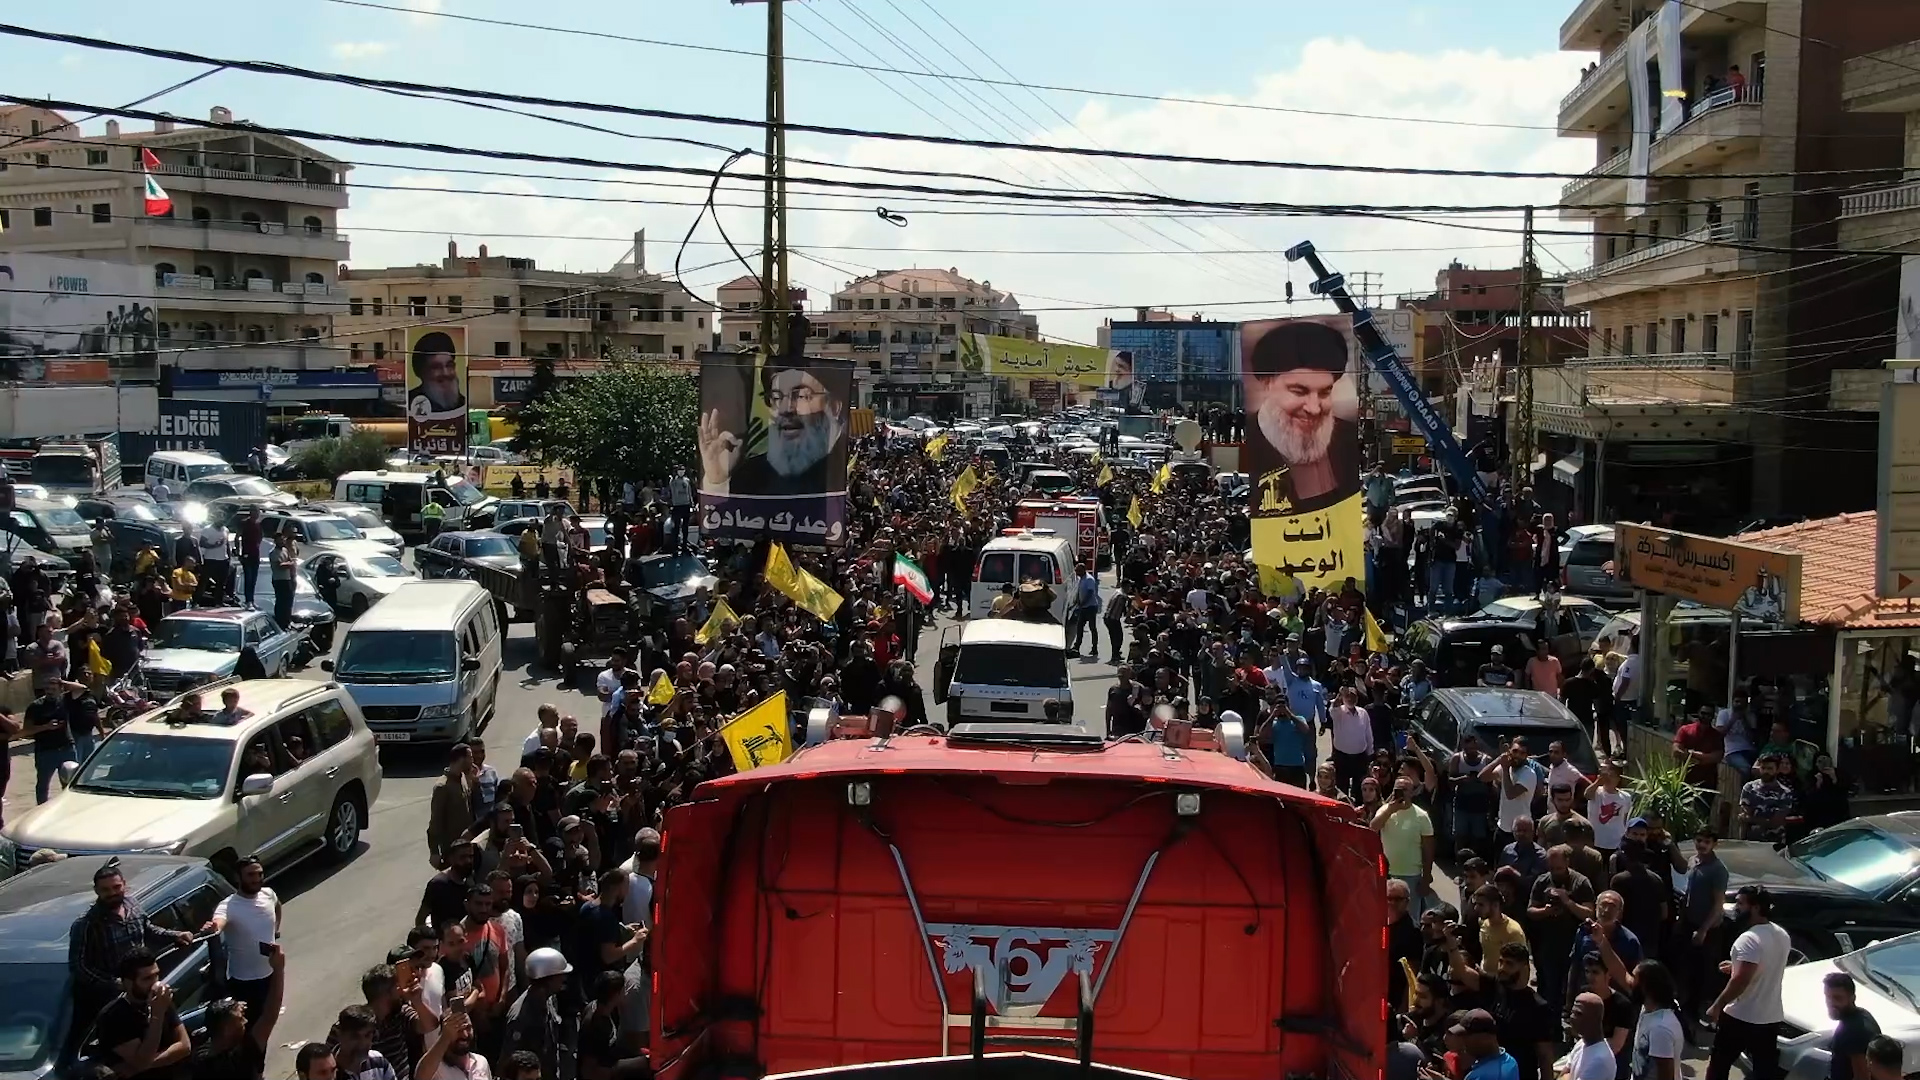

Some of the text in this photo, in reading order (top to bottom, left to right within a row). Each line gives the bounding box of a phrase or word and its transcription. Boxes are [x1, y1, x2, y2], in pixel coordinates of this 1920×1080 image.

[56, 275, 88, 293] POWER
[1055, 354, 1098, 378] خوش
[1414, 400, 1439, 431] RAAD
[702, 503, 843, 541] وعدك صادق
[1283, 512, 1331, 542] أنت
